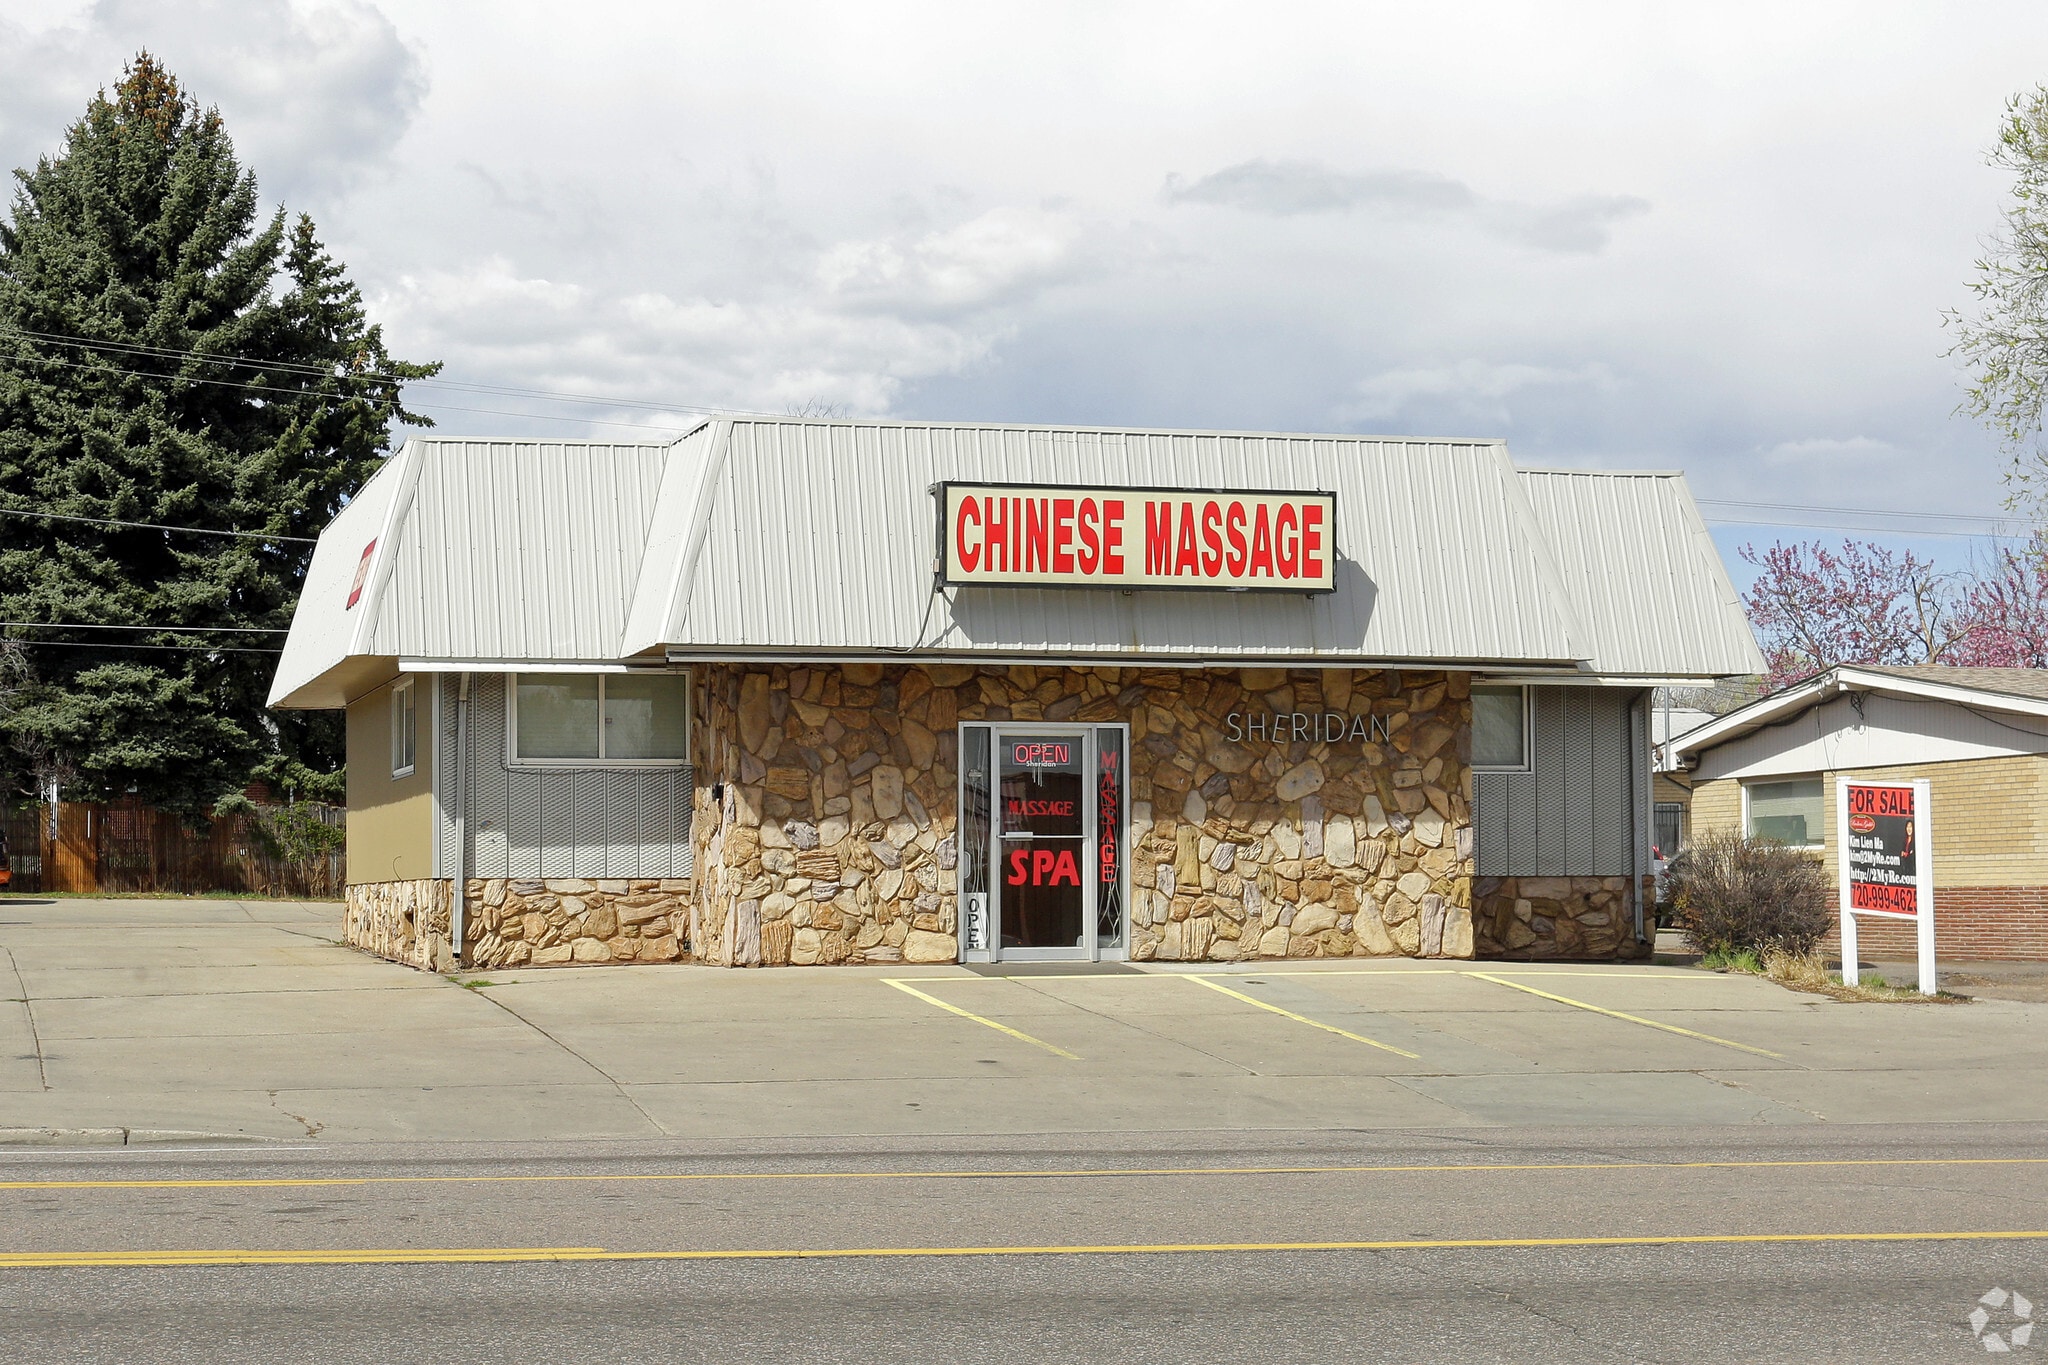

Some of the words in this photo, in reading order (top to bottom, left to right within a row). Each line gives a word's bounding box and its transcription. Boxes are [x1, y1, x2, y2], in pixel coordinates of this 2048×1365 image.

[956, 495, 1124, 574] CHINESE
[1145, 501, 1323, 579] MASSAGE
[1227, 712, 1390, 744] SHERIDAN
[1015, 744, 1068, 763] OPEN
[1008, 800, 1074, 816] MASSAGE
[1101, 751, 1117, 882] MASSAGE
[1848, 789, 1875, 813] FOR
[1880, 790, 1914, 815] SALE
[1008, 849, 1081, 886] SPA
